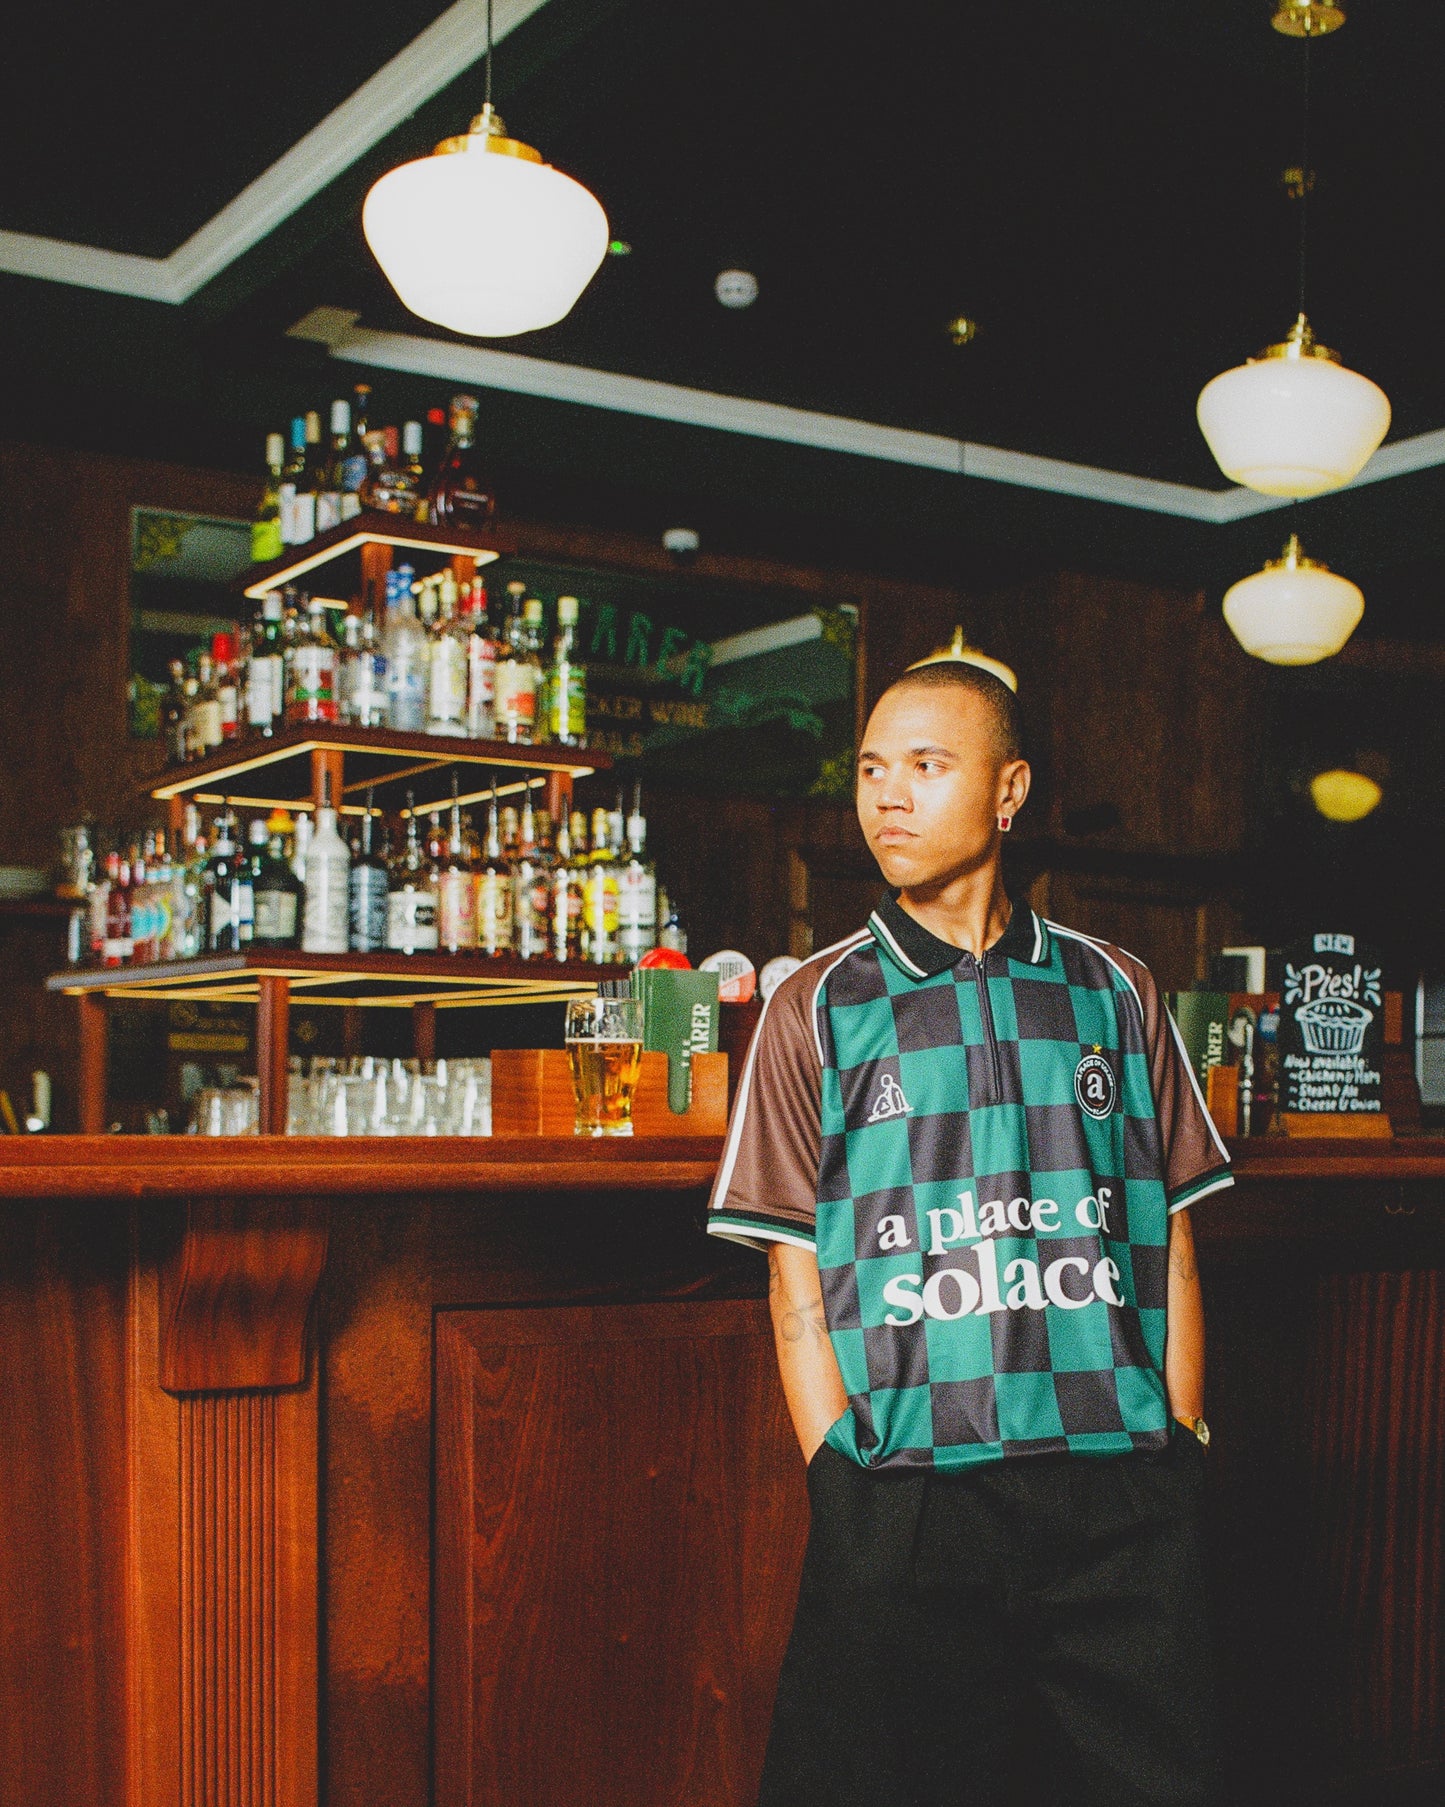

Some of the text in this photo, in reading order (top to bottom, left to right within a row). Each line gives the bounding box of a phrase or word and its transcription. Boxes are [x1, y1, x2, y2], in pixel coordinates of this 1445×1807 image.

[1300, 964, 1361, 1003] Pies!
[691, 1003, 711, 1055] ARER
[1208, 1021, 1223, 1067] ARER
[1087, 1073, 1105, 1100] a
[1298, 1097, 1337, 1112] Cheese
[877, 1187, 1112, 1256] a place of
[883, 1238, 1125, 1327] solace
